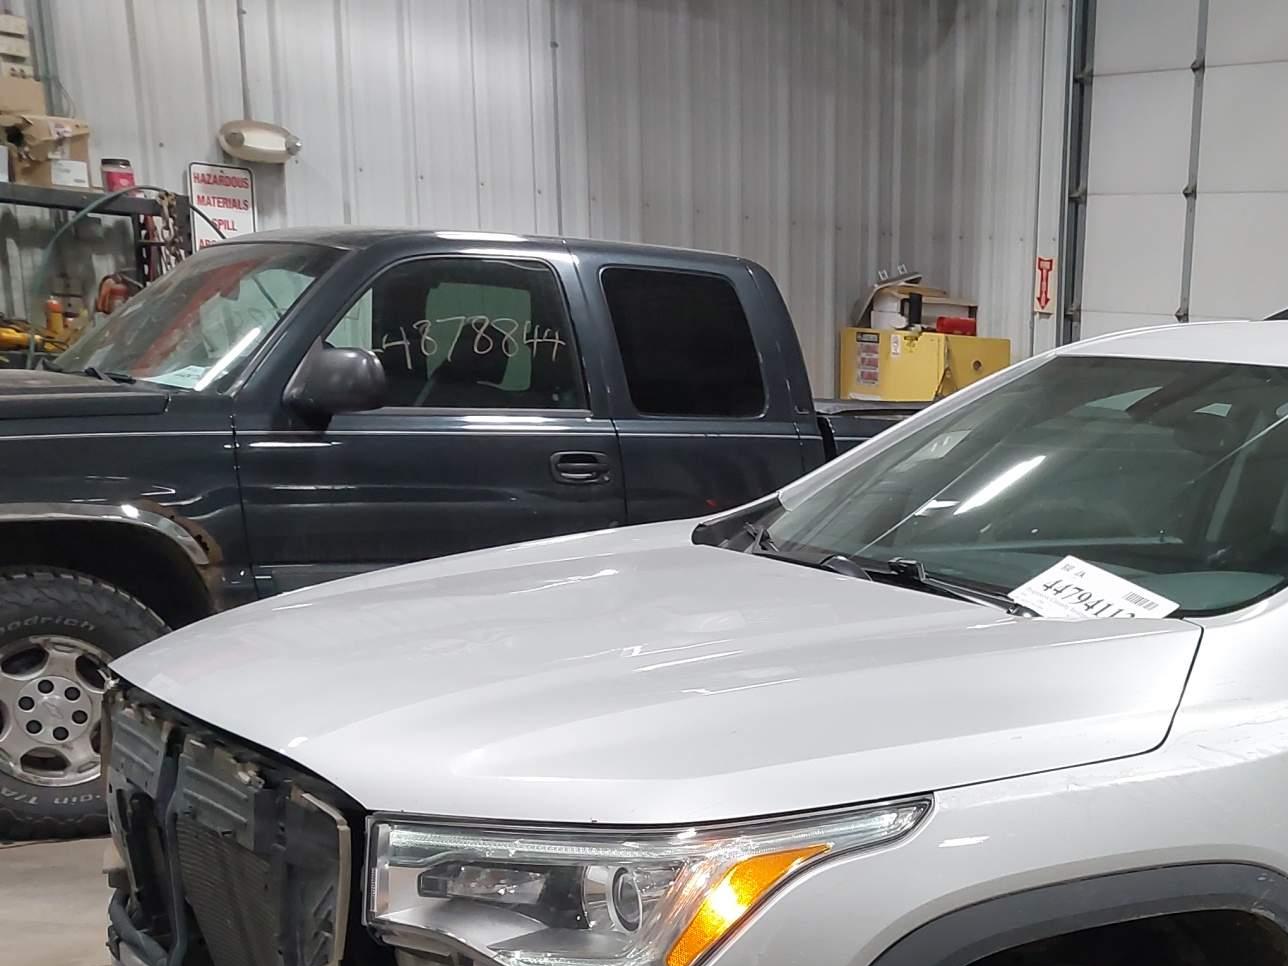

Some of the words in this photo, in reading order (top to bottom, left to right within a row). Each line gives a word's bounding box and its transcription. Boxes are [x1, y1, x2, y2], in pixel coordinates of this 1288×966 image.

[193, 172, 249, 189] HAZARDOUS
[197, 195, 249, 211] MATERIALS
[372, 315, 566, 370] 4878844
